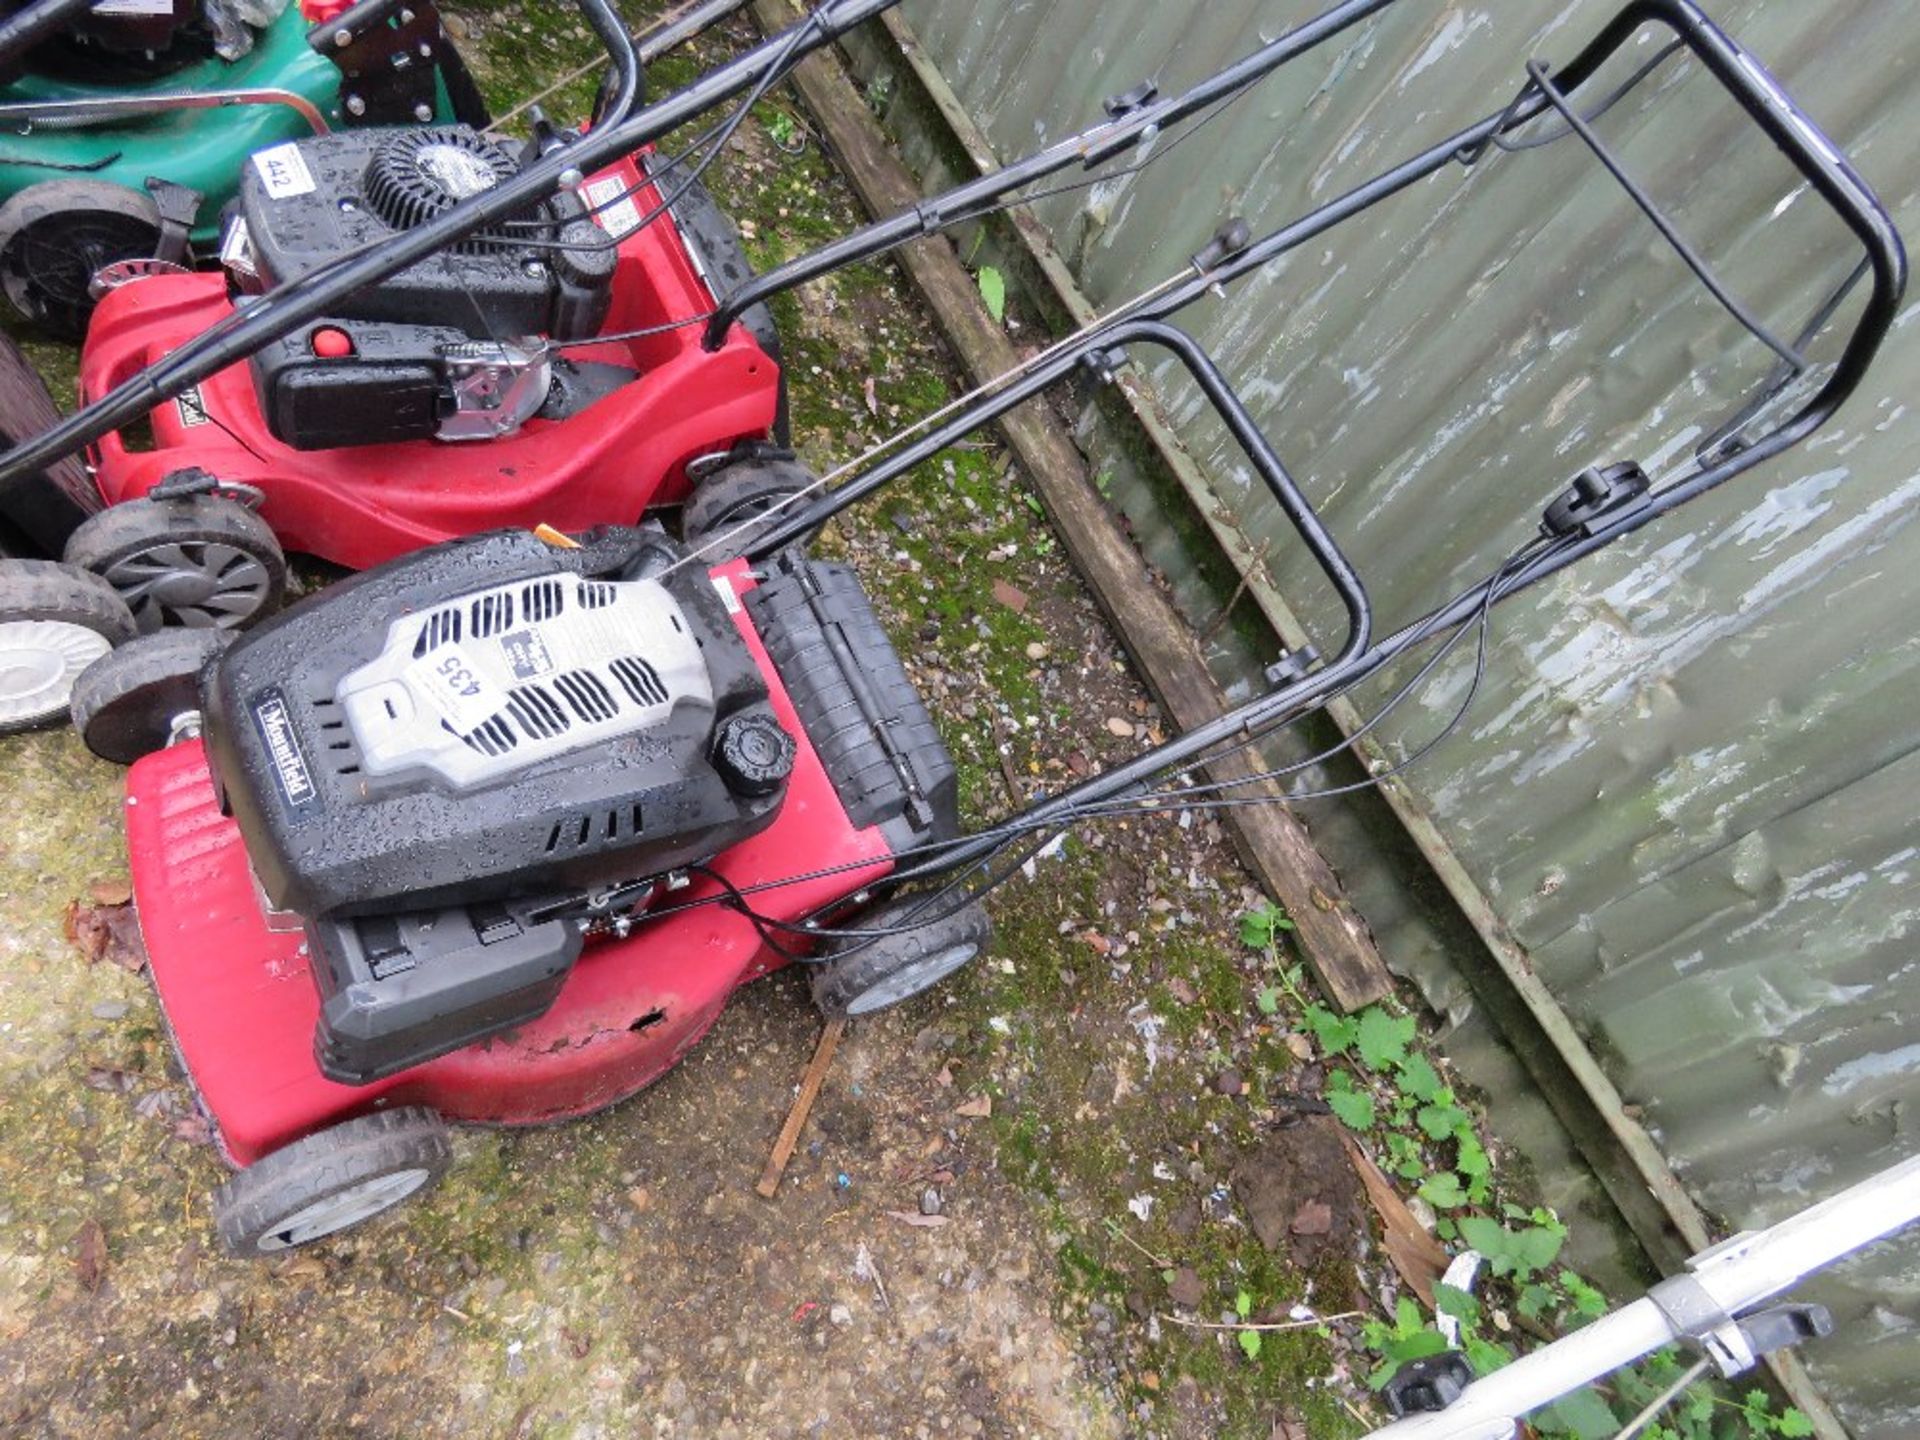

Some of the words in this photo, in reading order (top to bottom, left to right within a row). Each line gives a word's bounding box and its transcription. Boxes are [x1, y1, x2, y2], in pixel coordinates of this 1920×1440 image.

[266, 160, 292, 188] 442
[436, 656, 481, 697] 435
[262, 706, 309, 798] Mountfield
